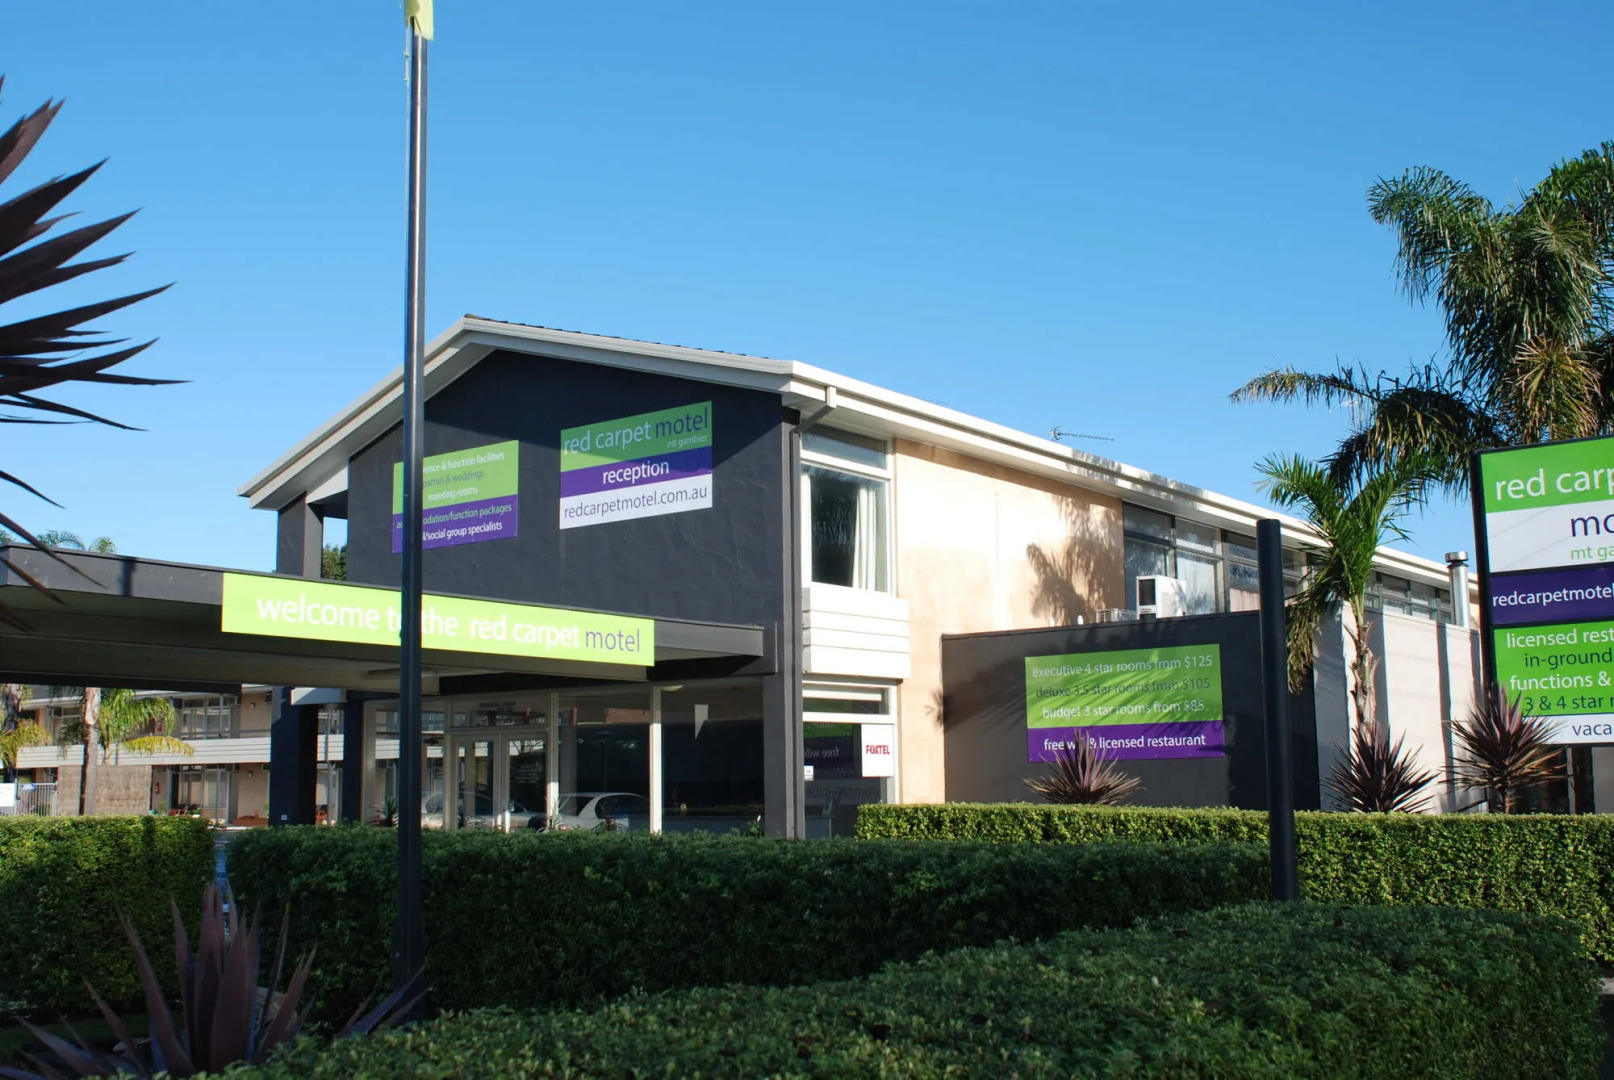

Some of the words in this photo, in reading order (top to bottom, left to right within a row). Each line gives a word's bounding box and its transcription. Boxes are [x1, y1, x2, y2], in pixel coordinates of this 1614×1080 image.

[564, 429, 591, 455] red
[595, 421, 652, 450] carpet
[655, 406, 708, 438] motel
[667, 440, 679, 449] mt
[679, 434, 709, 449] gambier
[441, 462, 448, 470] &
[447, 456, 476, 470] function
[477, 451, 505, 464] facilities
[446, 475, 451, 483] &
[451, 470, 485, 482] weddings
[602, 460, 670, 485] reception
[428, 489, 456, 502] meeting
[456, 486, 479, 497] rooms
[1495, 467, 1547, 501] red
[479, 503, 512, 519] packages
[564, 486, 708, 519] redcarpetmotel.com.au
[446, 527, 468, 540] group
[468, 521, 503, 536] specialists
[1570, 545, 1594, 560] mt
[256, 593, 380, 630] welcome
[421, 605, 460, 637] the
[470, 613, 508, 641] red
[513, 622, 580, 651] carpet
[585, 628, 640, 653] motel
[1506, 628, 1578, 649] licensed
[1032, 664, 1083, 678] executive
[1084, 663, 1092, 674] 4
[1094, 663, 1114, 674] star
[1116, 661, 1152, 673] rooms
[1154, 657, 1181, 670] from
[1184, 655, 1213, 669] $125
[1524, 647, 1613, 670] in-ground
[1036, 686, 1071, 698] deluxe
[1074, 684, 1089, 697] 3.5
[1092, 684, 1111, 695] star
[1114, 683, 1150, 694] rooms
[1152, 680, 1179, 692] from
[1182, 677, 1211, 691] $105
[1510, 673, 1593, 691] functions
[1597, 670, 1611, 687] &
[1042, 706, 1081, 720] budget
[1084, 705, 1091, 716] 3
[1093, 705, 1113, 716] star
[1115, 705, 1151, 715] rooms
[1153, 701, 1181, 713] from
[1184, 699, 1205, 712] $85
[1524, 696, 1533, 711] 3
[1539, 695, 1552, 711] &
[1556, 696, 1567, 709] 4
[1572, 695, 1604, 710] star
[1572, 723, 1613, 737] vaca
[865, 745, 890, 755] FOXTEL
[1044, 738, 1065, 751] free
[1099, 736, 1145, 749] licensed
[1147, 734, 1206, 747] restaurant
